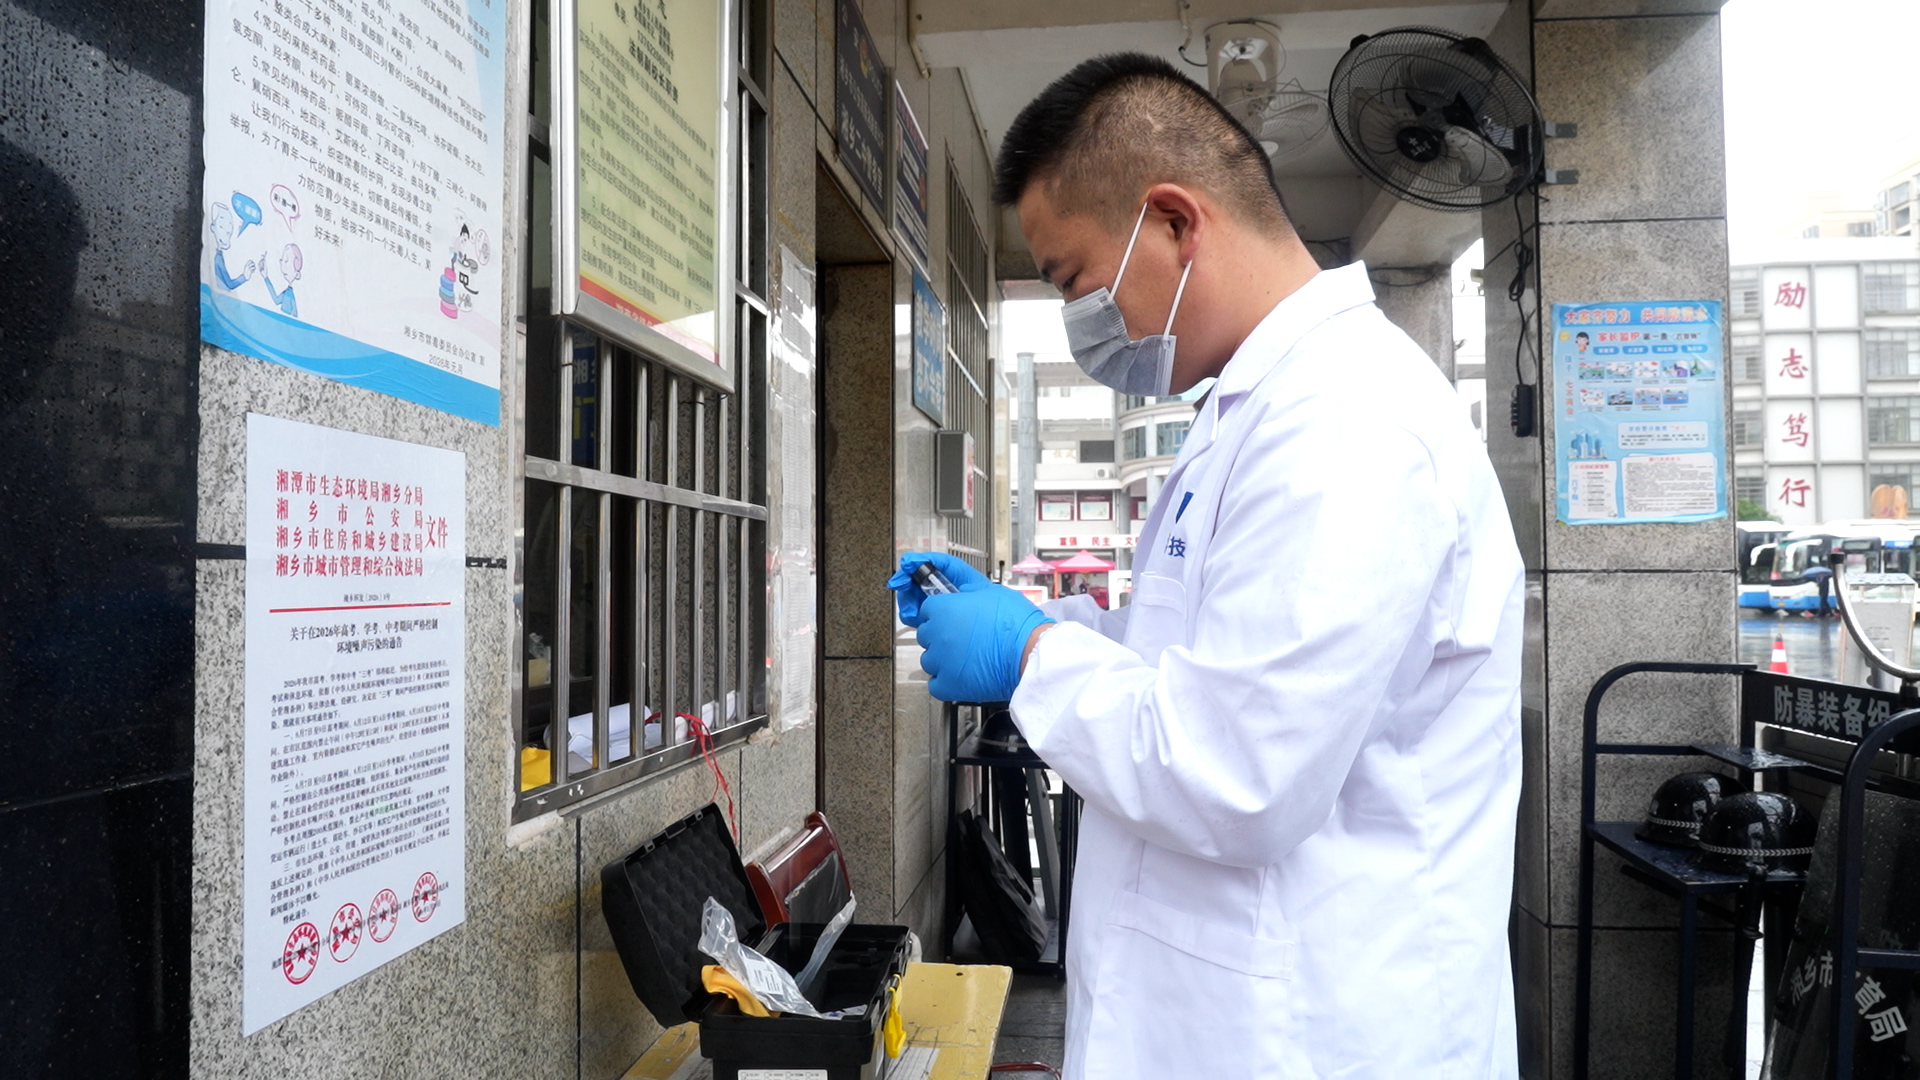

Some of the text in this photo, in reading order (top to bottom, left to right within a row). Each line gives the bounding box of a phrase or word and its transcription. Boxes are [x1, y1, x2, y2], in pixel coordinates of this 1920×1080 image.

[1564, 308, 1631, 325] 大家齐努力
[1774, 281, 1812, 508] 励志笃行
[275, 467, 422, 506] 湘潭市生态环境局湘乡分局
[275, 497, 422, 529] 湘乡市公安局
[275, 524, 422, 553] 湘乡市住房和城乡建设局
[424, 514, 447, 549] 文件
[1059, 536, 1078, 546] 富强
[1091, 536, 1111, 546] 民主
[275, 552, 422, 577] 湘乡市城市管理和综合执法局
[289, 617, 438, 642] 关于在2026年高考、学考、中考期间严格控制
[336, 635, 403, 656] 环境噪声污染的通告
[1773, 685, 1892, 738] 防暴装备组
